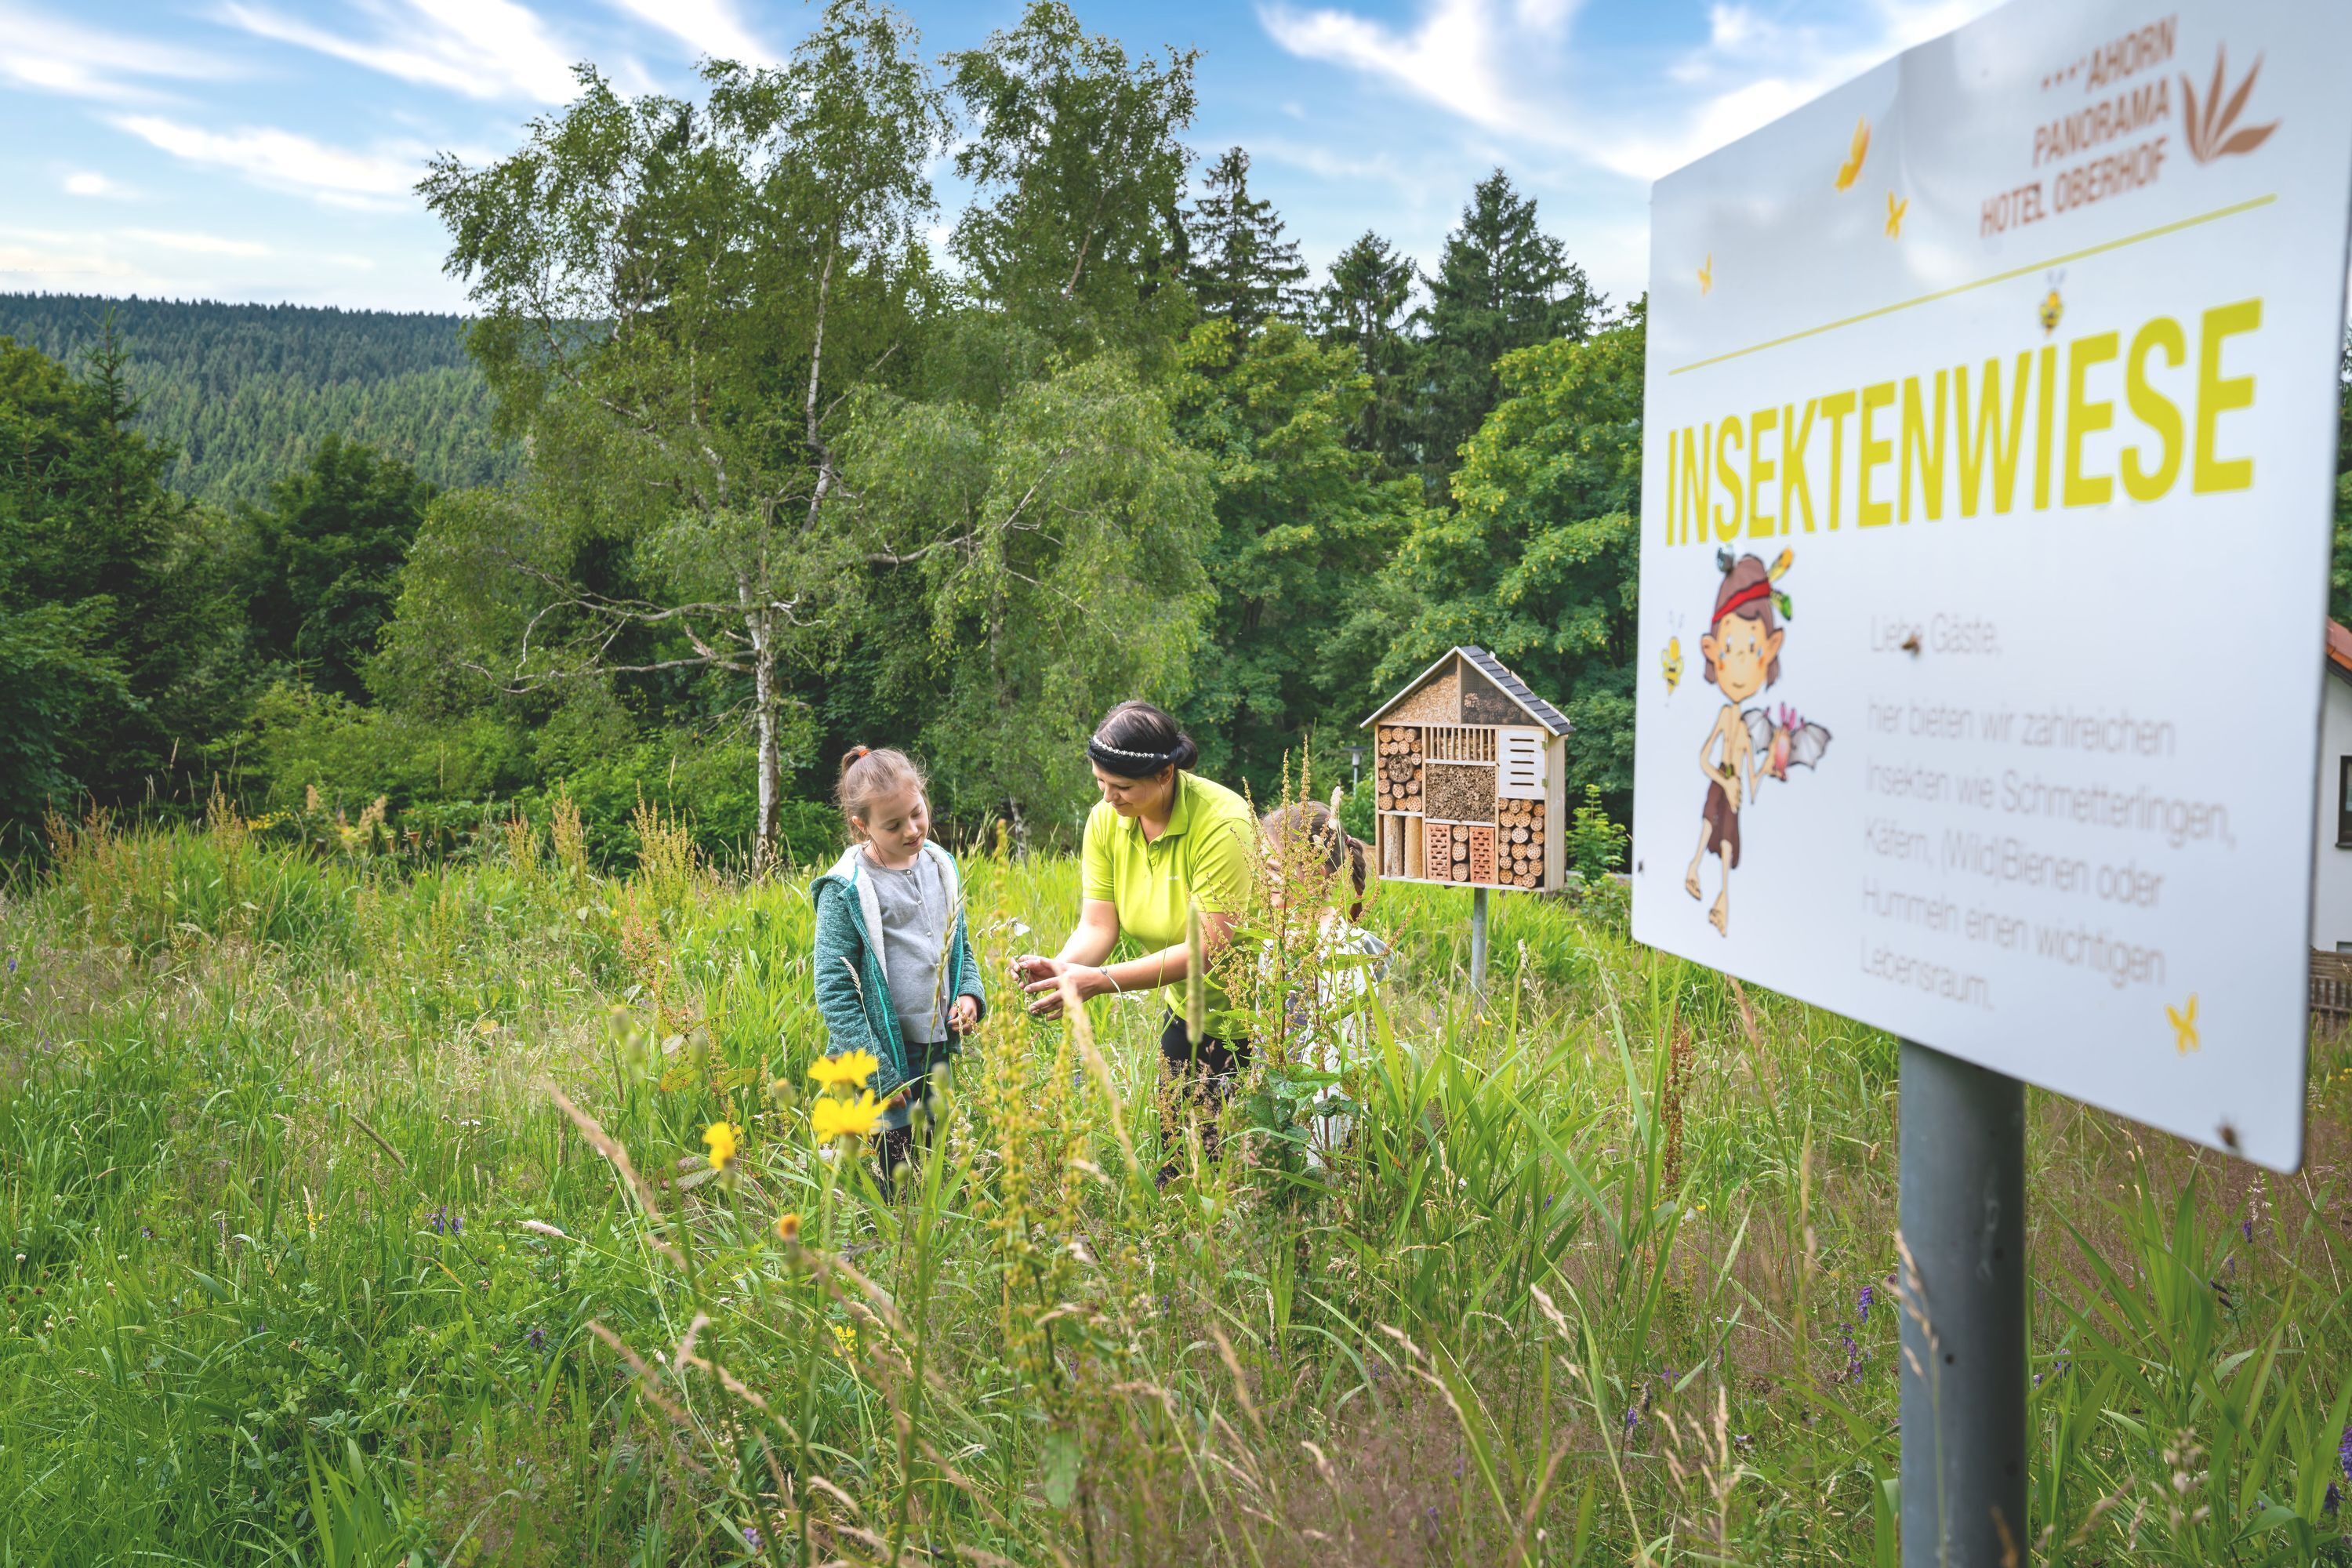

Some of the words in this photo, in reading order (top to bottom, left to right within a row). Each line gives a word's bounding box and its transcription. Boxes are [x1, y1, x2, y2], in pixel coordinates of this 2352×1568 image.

[2085, 13, 2177, 93] AHORN
[2033, 76, 2169, 168] PANORAMA
[1980, 181, 2045, 238] HOTEL
[2053, 135, 2168, 214] OBERHOF
[1667, 298, 2264, 546] INSEKTENWIESE
[1931, 612, 2002, 657] Gäste,
[1868, 693, 1903, 735] hier
[1908, 697, 1974, 739] bieten
[1980, 700, 2014, 742] wir
[2020, 705, 2176, 757] zahlreichen
[1867, 754, 1951, 802] Insekten
[1956, 764, 1994, 809] wie
[2001, 768, 2238, 852] Schmetterlingen,
[1865, 816, 1934, 868] Käfern,
[2096, 858, 2166, 908] oder
[1861, 935, 1994, 1011] Lebensraum.
[1863, 874, 1959, 935] Hummeln
[1965, 899, 2027, 953] einen
[2035, 917, 2167, 989] wichtigen
